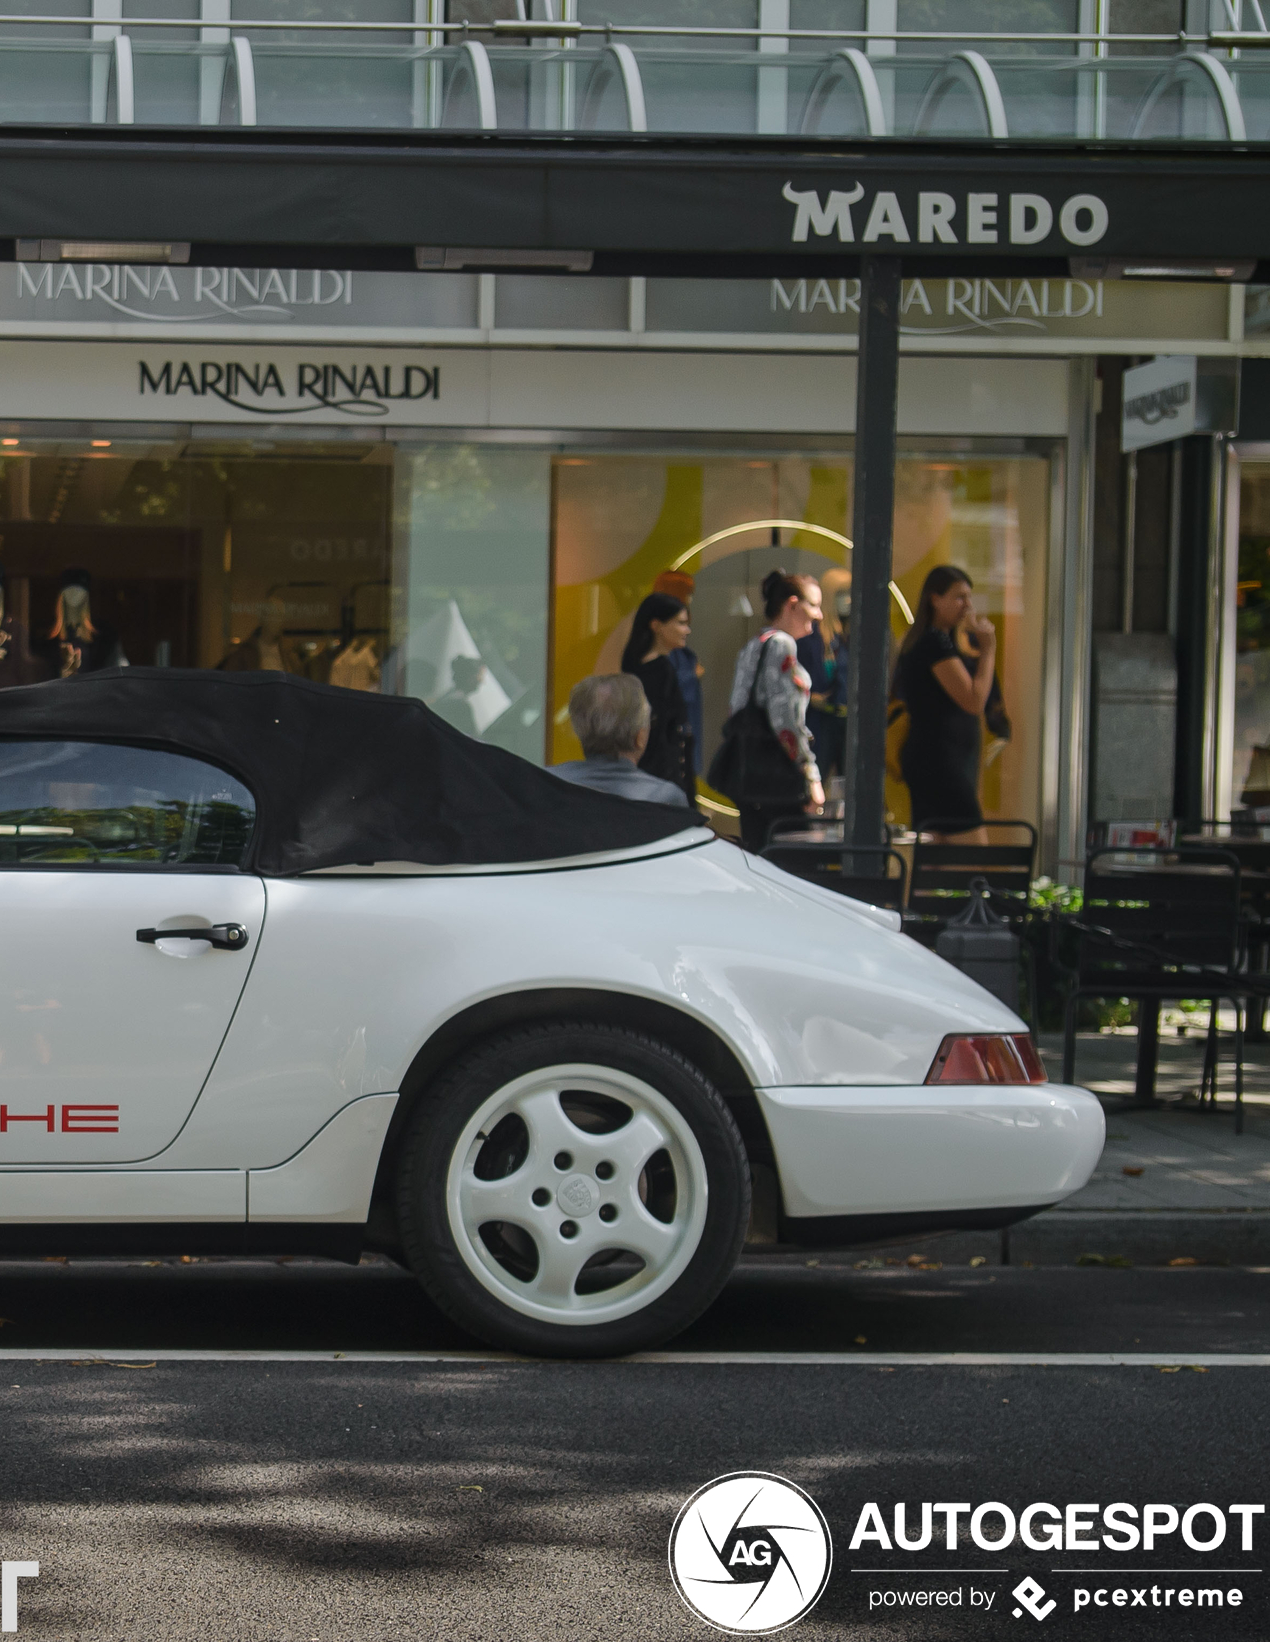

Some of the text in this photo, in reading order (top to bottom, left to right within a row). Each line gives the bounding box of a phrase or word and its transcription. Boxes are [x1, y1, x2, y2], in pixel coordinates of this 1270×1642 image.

[782, 181, 1110, 246] MAREDO
[16, 262, 355, 320] MARINA RINALDI
[945, 279, 1104, 333] RINALDI
[139, 361, 440, 417] MARINA RINALDI
